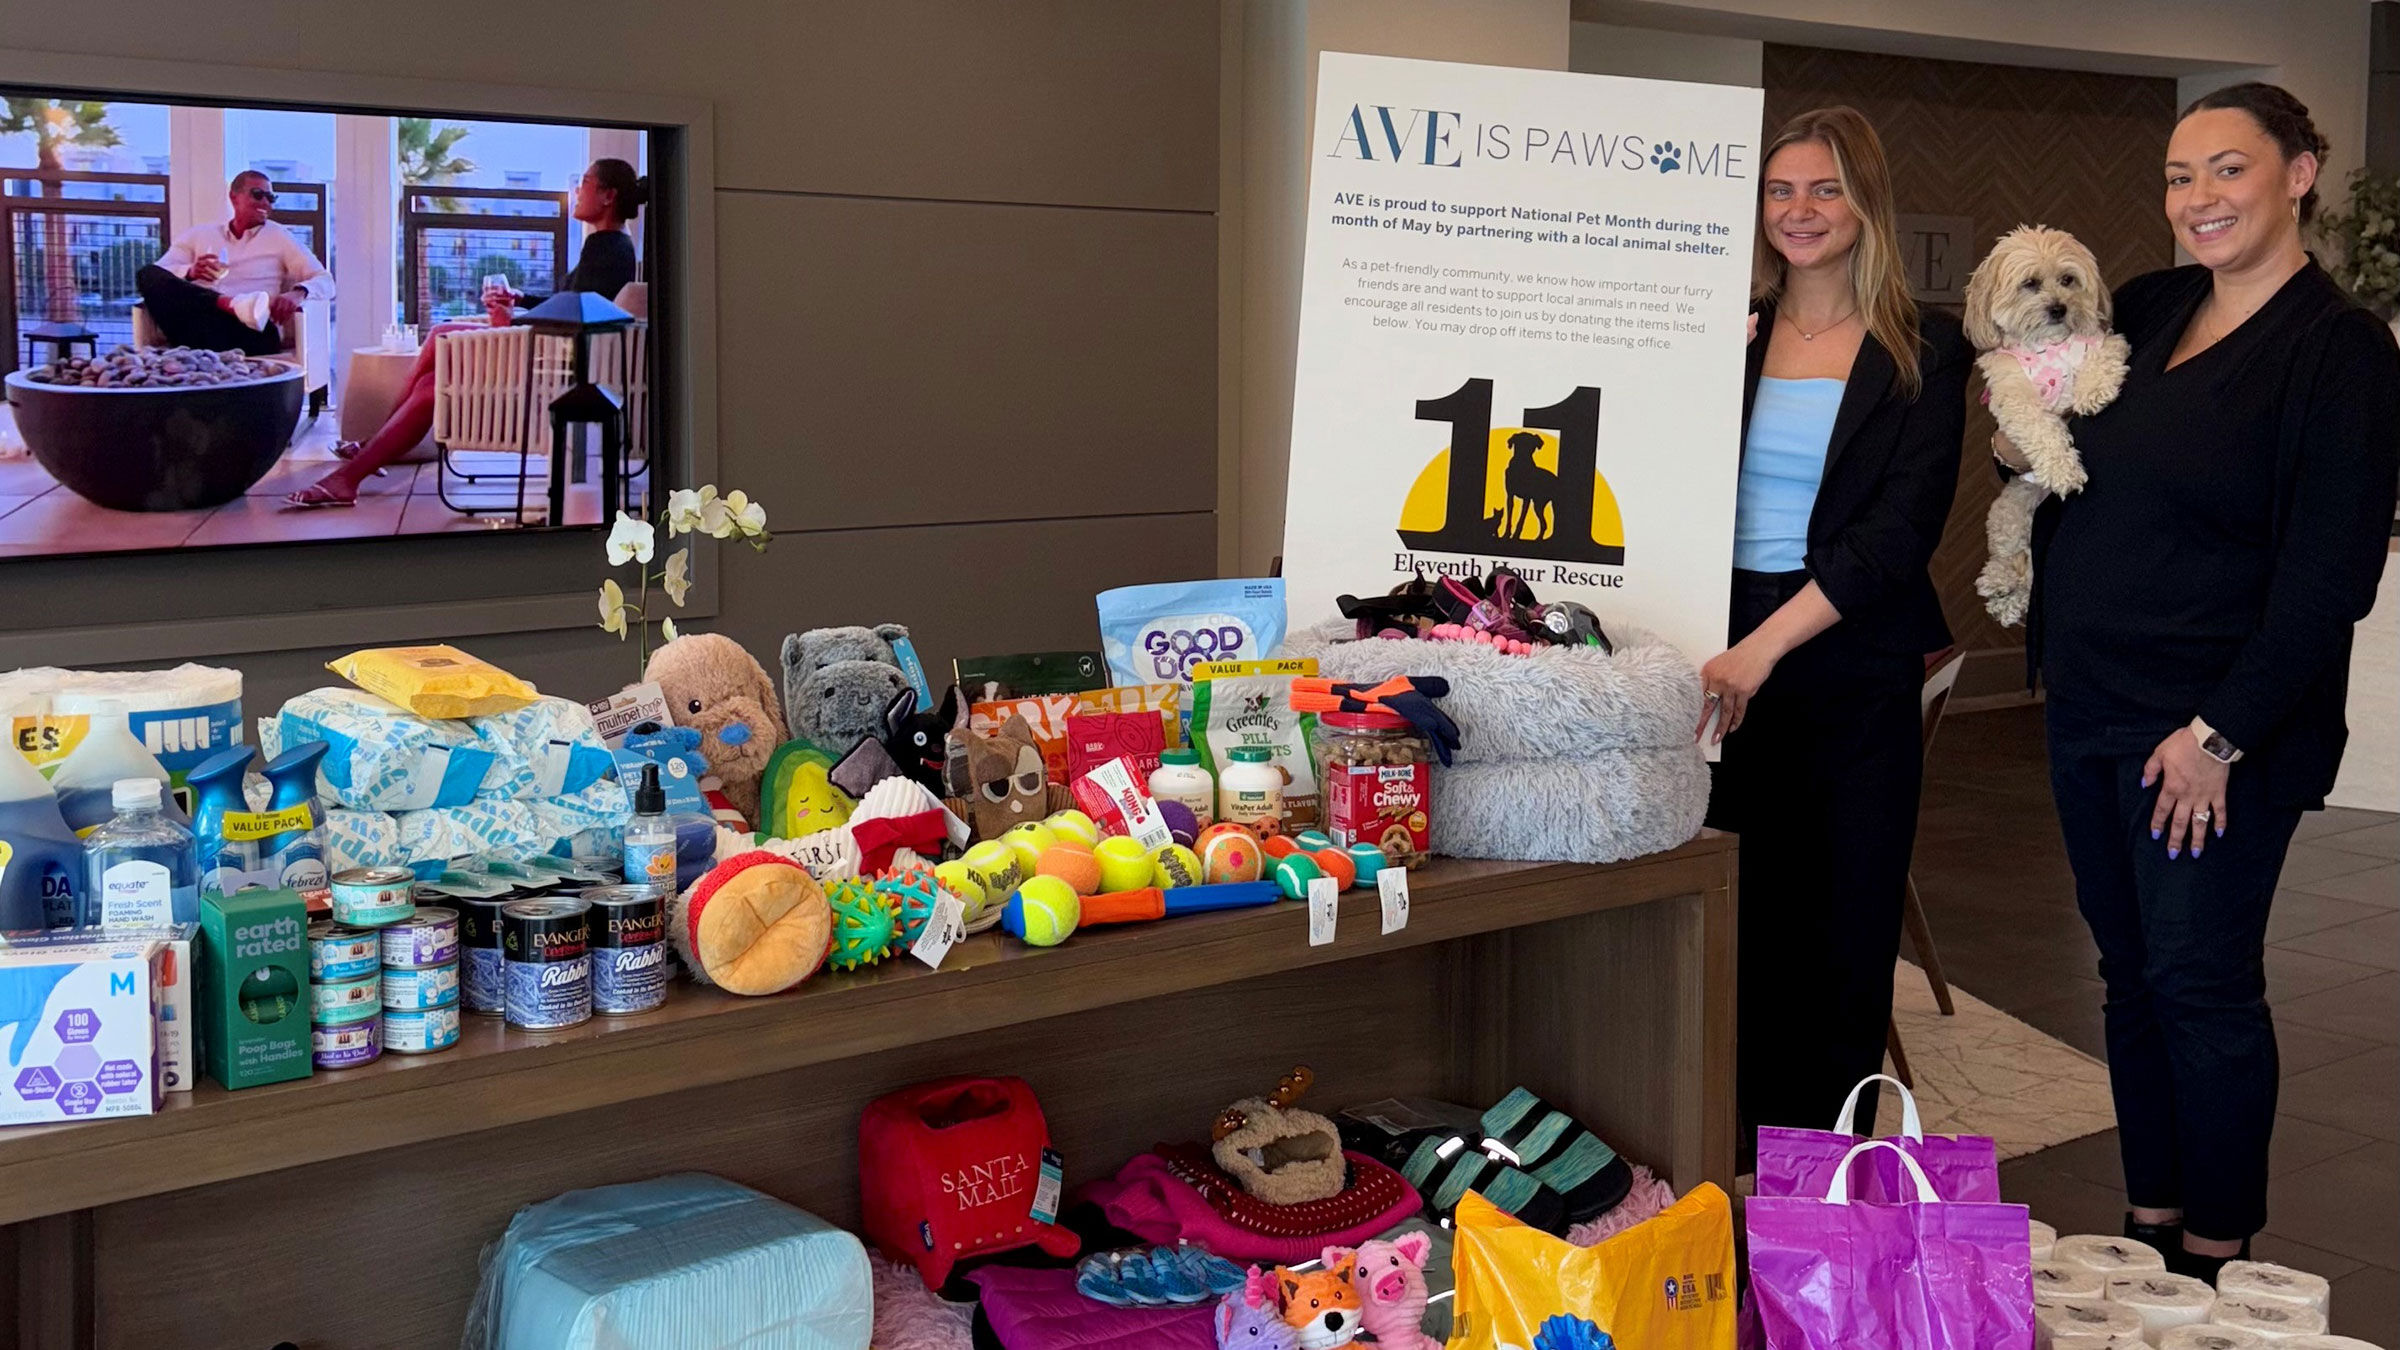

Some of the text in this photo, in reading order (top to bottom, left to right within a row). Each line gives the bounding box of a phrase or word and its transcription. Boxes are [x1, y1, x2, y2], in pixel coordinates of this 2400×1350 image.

[1327, 102, 1462, 168] AVE
[1476, 124, 1511, 160] IS
[1334, 192, 1730, 236] AVE is proud to support National Pet Month during the
[1331, 215, 1729, 256] month of May by partnering with a local animal shelter.
[1342, 257, 1358, 269] As
[1360, 261, 1368, 270] a
[1370, 261, 1439, 278] pet-friendly
[1517, 274, 1533, 283] we
[1536, 273, 1568, 286] know
[1571, 276, 1596, 288] how
[1599, 281, 1658, 294] important
[1660, 285, 1681, 295] our
[1684, 285, 1713, 300] furry
[1358, 277, 1399, 291] friends
[1402, 283, 1421, 293] are
[1424, 284, 1447, 295] and
[1450, 287, 1478, 298] want
[1482, 288, 1494, 299] to
[1496, 291, 1543, 303] support
[1546, 292, 1574, 305] local
[1577, 297, 1623, 309] animals
[1626, 301, 1637, 309] in
[1676, 302, 1695, 315] We
[1344, 297, 1705, 334] encourage all residents to join us by donating the items listed
[1415, 319, 1437, 331] You
[1440, 323, 1466, 336] may
[1469, 323, 1497, 337] drop
[1500, 325, 1516, 337] off
[1519, 328, 1552, 340] items
[1555, 330, 1568, 341] to
[1570, 331, 1590, 343] the
[1593, 333, 1635, 349] leasing
[1393, 553, 1482, 578] Eleventh
[1552, 565, 1624, 588] Rescue
[1145, 626, 1243, 655] GOOD
[1210, 662, 1304, 673] VALUE PACK
[597, 707, 641, 733] multipet
[1226, 711, 1279, 732] Greenies
[1242, 733, 1272, 744] PILL
[1121, 787, 1143, 816] KONG
[1256, 803, 1273, 811] Adult
[1373, 792, 1421, 807] Chewy
[233, 816, 304, 832] VALUE PACK
[791, 843, 841, 865] FIRST
[108, 881, 146, 893] equate
[108, 899, 162, 909] Fresh Scent
[108, 915, 130, 923] HAND
[234, 916, 300, 941] earth
[235, 933, 301, 958] rated
[615, 945, 663, 973] Rabbit
[110, 971, 135, 996] M
[540, 960, 589, 989] Rabbit
[67, 1013, 89, 1027] 100
[238, 1038, 297, 1055] Poop Bags
[239, 1048, 304, 1066] with Handles
[941, 1154, 1029, 1193] SANTA
[957, 1175, 1023, 1211] MAIL
